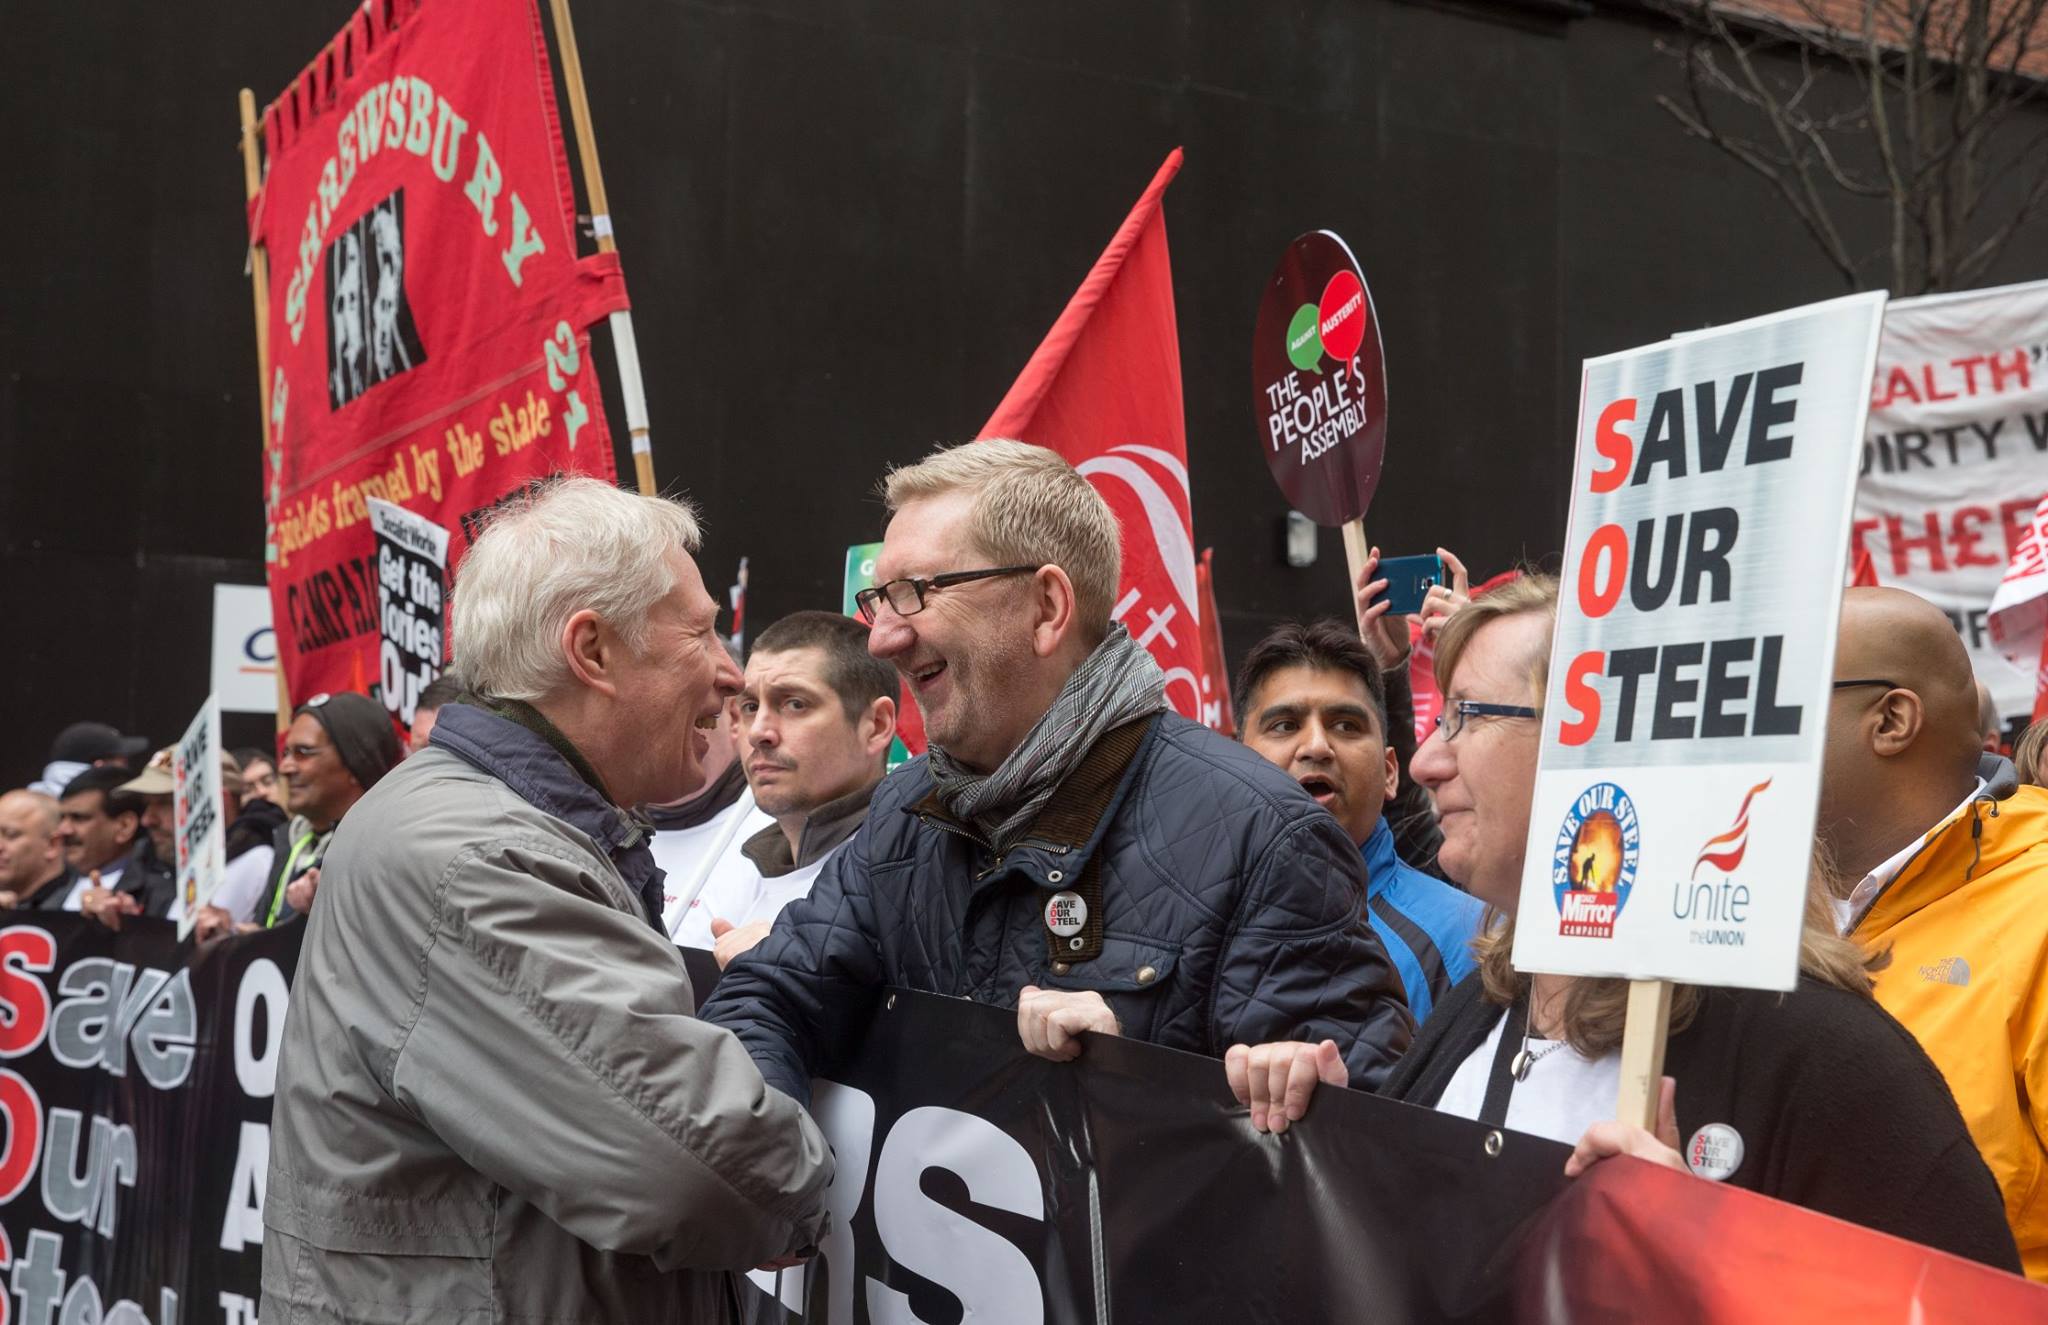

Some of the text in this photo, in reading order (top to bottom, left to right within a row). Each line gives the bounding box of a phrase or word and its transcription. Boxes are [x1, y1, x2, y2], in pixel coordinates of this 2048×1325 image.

[285, 75, 546, 346] SHREWSBURY
[1321, 291, 1362, 336] AUSTERITY
[1291, 325, 1316, 351] AGAINST
[1266, 371, 1301, 411] THE
[1301, 396, 1367, 465] ASSEMBLY
[1590, 361, 1804, 494] SAVE
[333, 452, 412, 529] framed
[410, 444, 442, 502] by
[445, 423, 484, 478] the
[489, 390, 551, 456] state
[379, 543, 441, 615] Get the
[1577, 507, 1739, 619] OUR
[288, 555, 380, 656] CAMPAI
[379, 584, 441, 667] Tories
[1558, 634, 1804, 748] STEEL
[1554, 785, 1638, 887] SAVE OUR STEEL
[1050, 909, 1070, 918] OUR
[1050, 917, 1081, 926] STEEL
[1051, 900, 1076, 909] SAVE
[1561, 893, 1617, 923] Mirror
[1673, 878, 1751, 923] unite
[1563, 925, 1610, 937] CAMPAIGN
[0, 925, 197, 1090] Save
[1692, 1156, 1729, 1169] STEEL
[1694, 1145, 1721, 1157] OUR
[1696, 1134, 1730, 1147] SAVE
